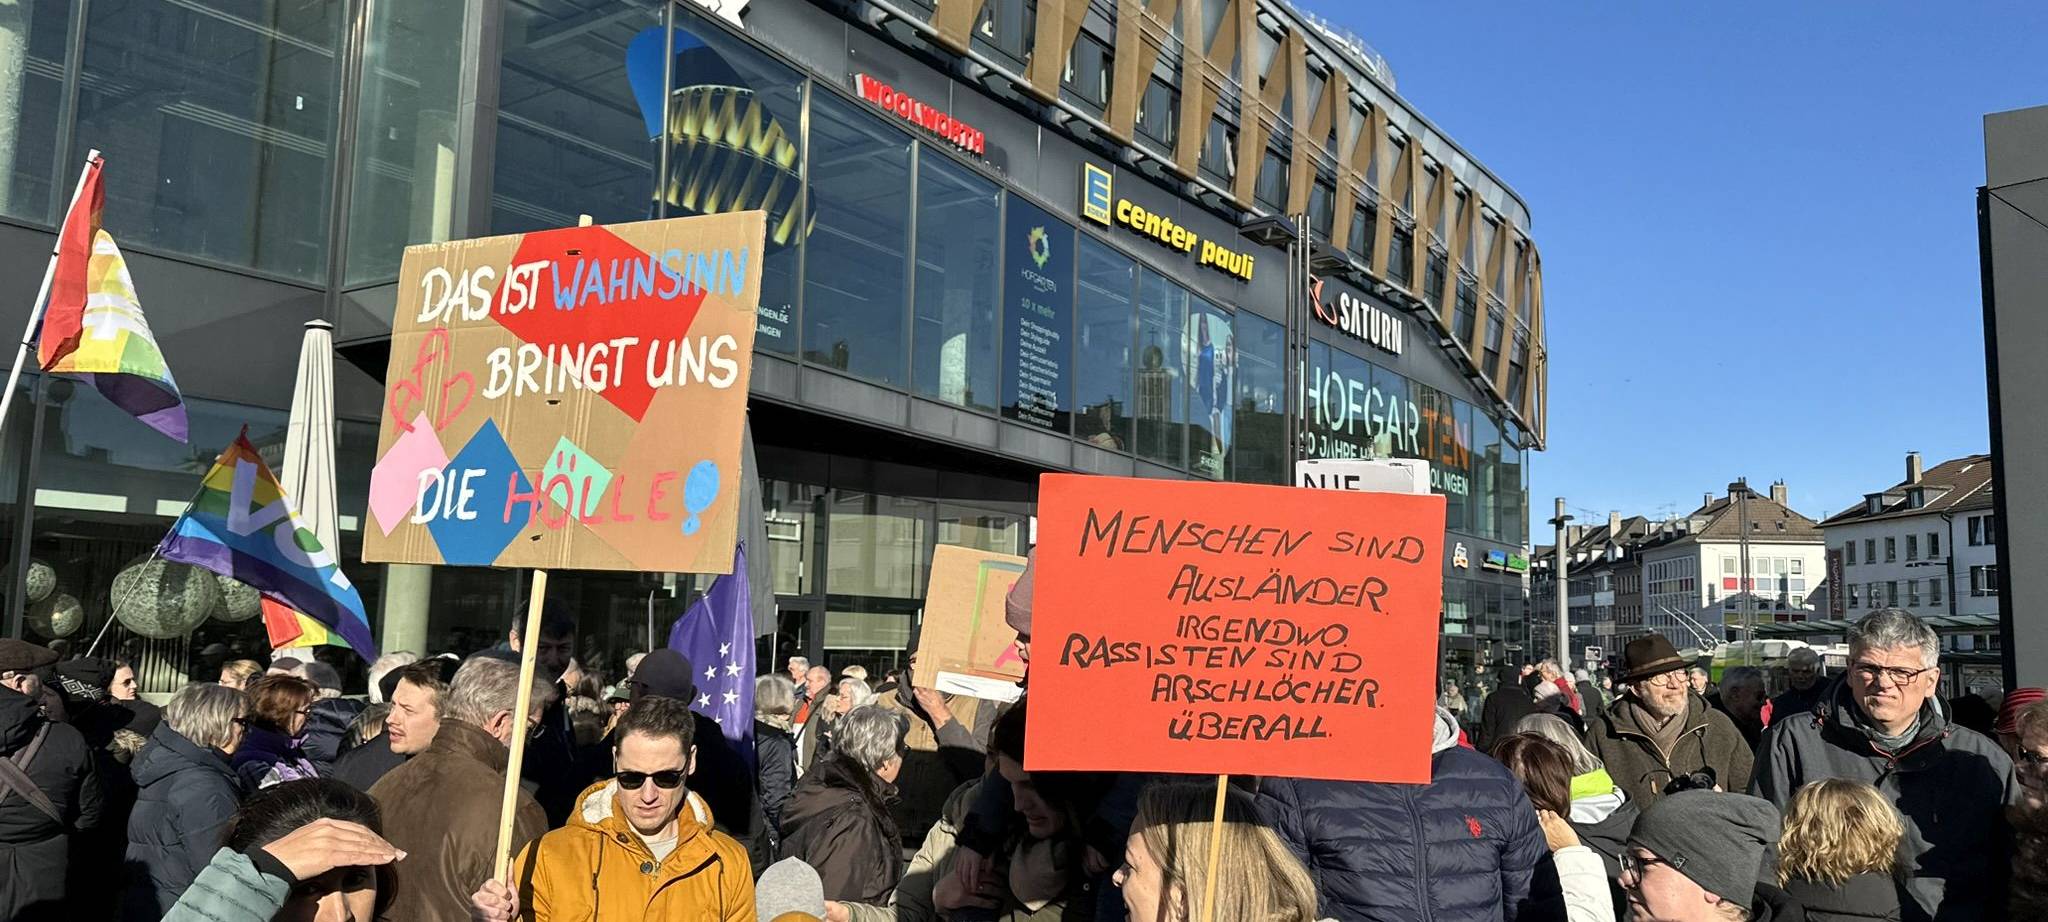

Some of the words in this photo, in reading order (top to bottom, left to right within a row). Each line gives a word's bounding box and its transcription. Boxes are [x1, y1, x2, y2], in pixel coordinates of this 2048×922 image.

[855, 73, 985, 154] WOOLWORTH
[1116, 198, 1198, 253] center
[1200, 239, 1255, 281] pauli
[416, 265, 496, 324] DAS
[500, 259, 551, 315] IST
[551, 247, 749, 312] WAHNSINN
[1339, 291, 1402, 355] SATURN
[482, 336, 640, 400] BRINGT
[646, 334, 739, 390] UNS
[1320, 435, 1358, 459] JAHRE
[410, 467, 487, 525] DIE
[503, 450, 721, 537] HÖLLE!
[1078, 507, 1312, 558] MENSCHEN
[1328, 530, 1425, 564] SIND
[1167, 563, 1390, 616] AUSLÄNDER.
[1058, 632, 1257, 669] RASSISTEN
[1264, 648, 1363, 673] SIND
[1176, 614, 1350, 649] IRGENDWO.
[1150, 672, 1385, 708] ARSCHLÖCHER.
[1168, 710, 1333, 742] ÜBERALL.
